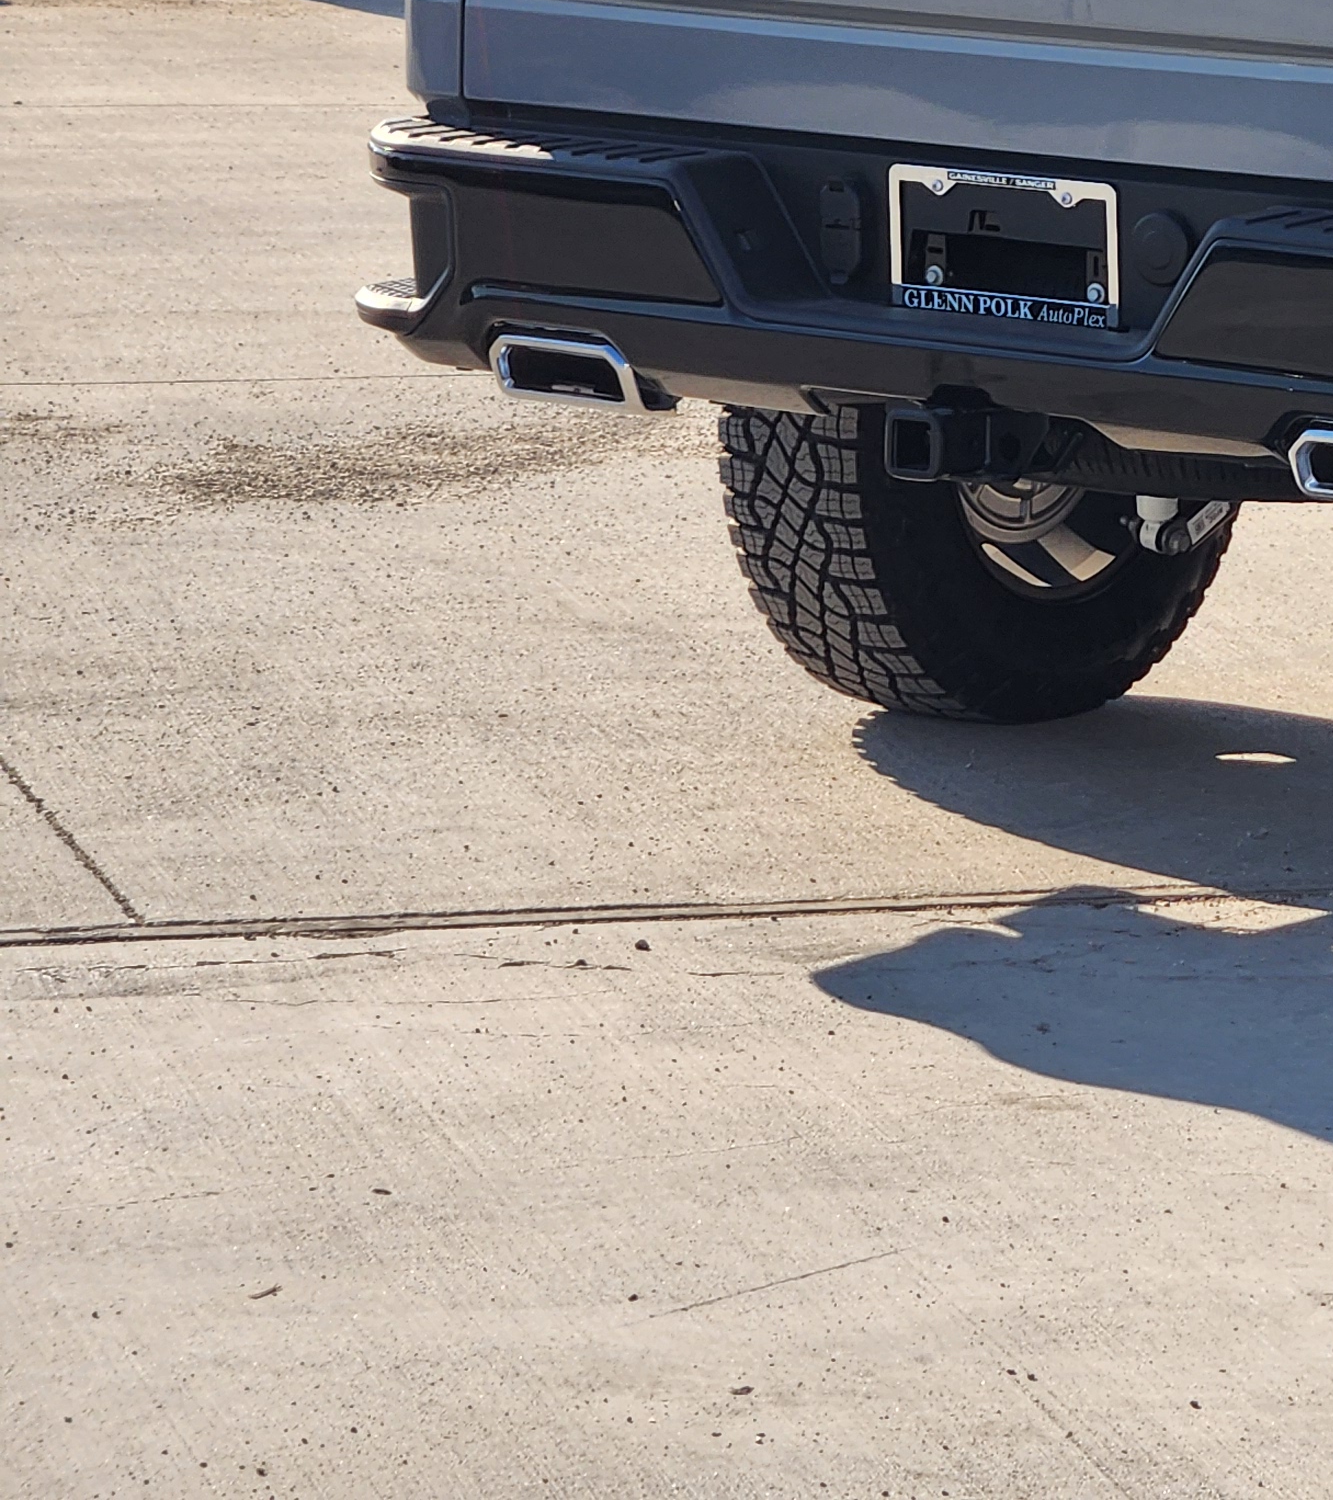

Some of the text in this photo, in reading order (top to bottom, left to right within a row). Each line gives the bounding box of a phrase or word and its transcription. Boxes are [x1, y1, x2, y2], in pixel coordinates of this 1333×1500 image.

[948, 172, 1007, 185] GAINESVILLE
[1015, 179, 1055, 190] SANGER
[904, 289, 1106, 329] GLENN POLK AutoPlex
